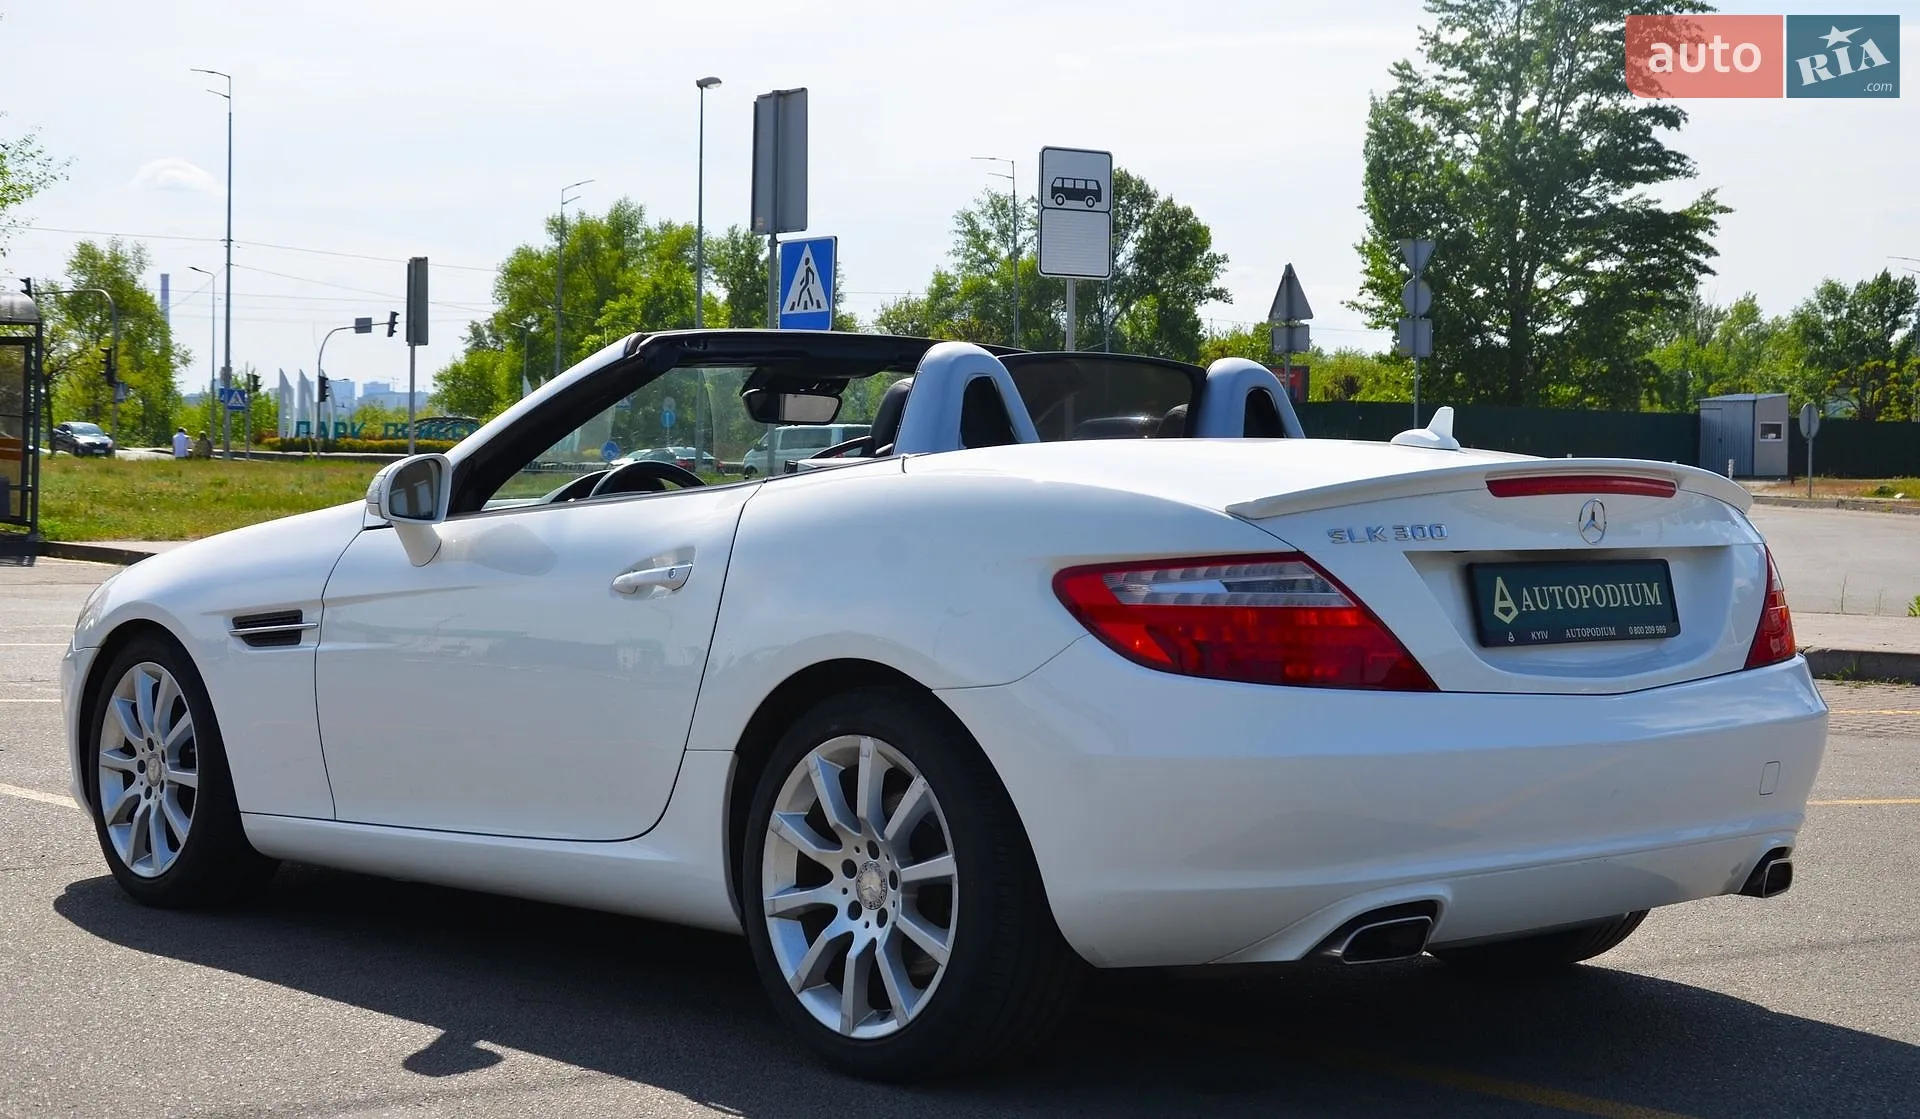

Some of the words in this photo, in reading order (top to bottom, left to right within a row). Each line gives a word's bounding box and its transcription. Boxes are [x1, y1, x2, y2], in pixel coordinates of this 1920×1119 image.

[1327, 526, 1387, 544] SLK
[1392, 523, 1448, 541] 300
[1522, 582, 1662, 611] AUTOPODIUM
[1531, 630, 1549, 640] KYIV
[1565, 626, 1616, 639] AUTOPODIUM
